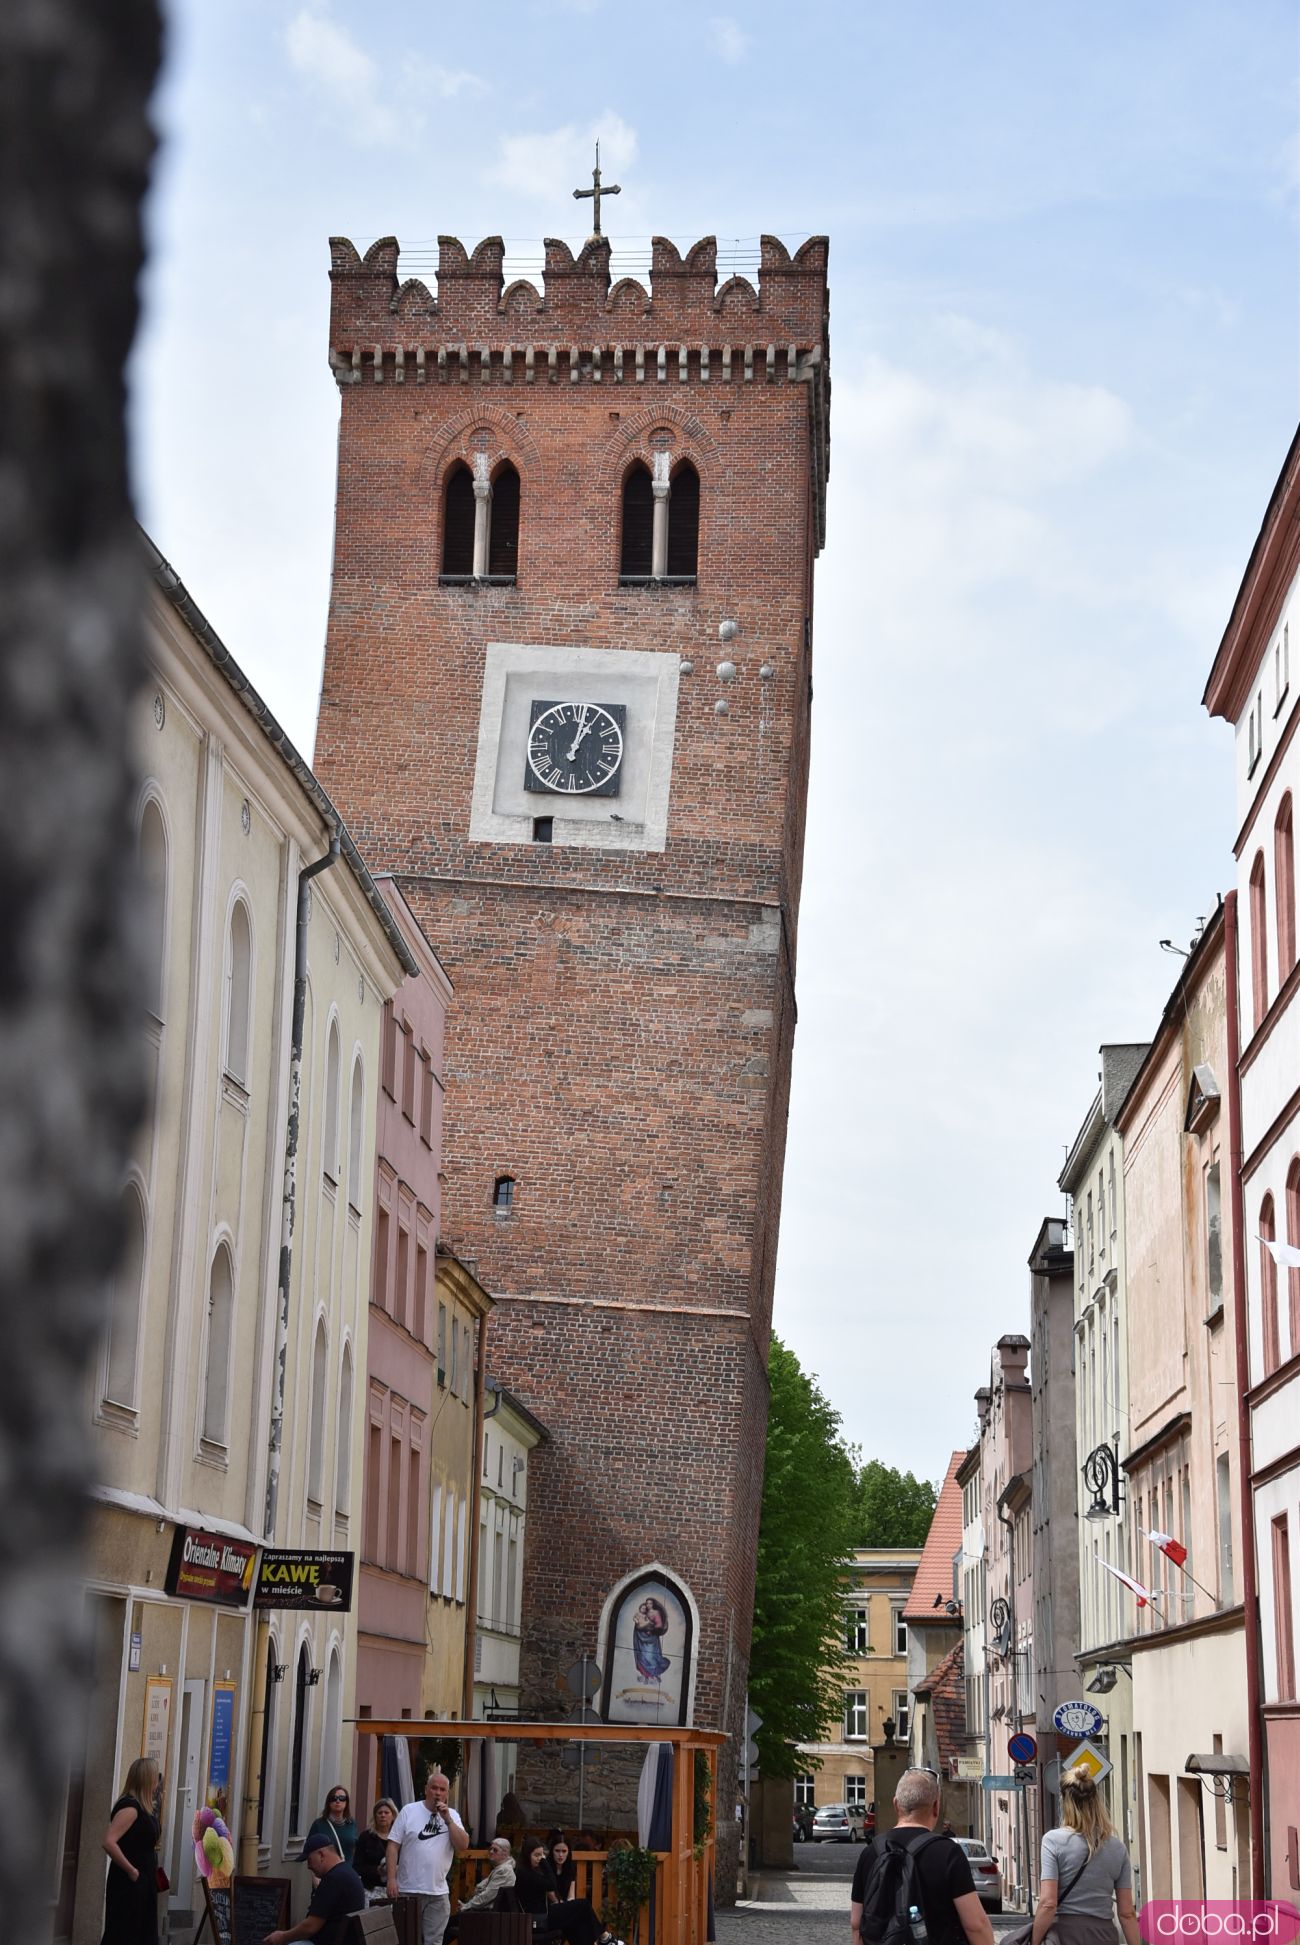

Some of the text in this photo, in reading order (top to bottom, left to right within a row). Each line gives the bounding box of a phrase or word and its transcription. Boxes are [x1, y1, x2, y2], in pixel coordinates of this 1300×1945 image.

[183, 1536, 220, 1569] Orientalne
[220, 1545, 247, 1579] Klimaty
[263, 1552, 303, 1562] Zapraszamy
[314, 1554, 345, 1564] najlepszą
[261, 1564, 320, 1587] KAWĘ
[271, 1585, 303, 1594] mieście
[1055, 1702, 1100, 1720] STOMATOLOG
[1059, 1726, 1083, 1737] JOANNA
